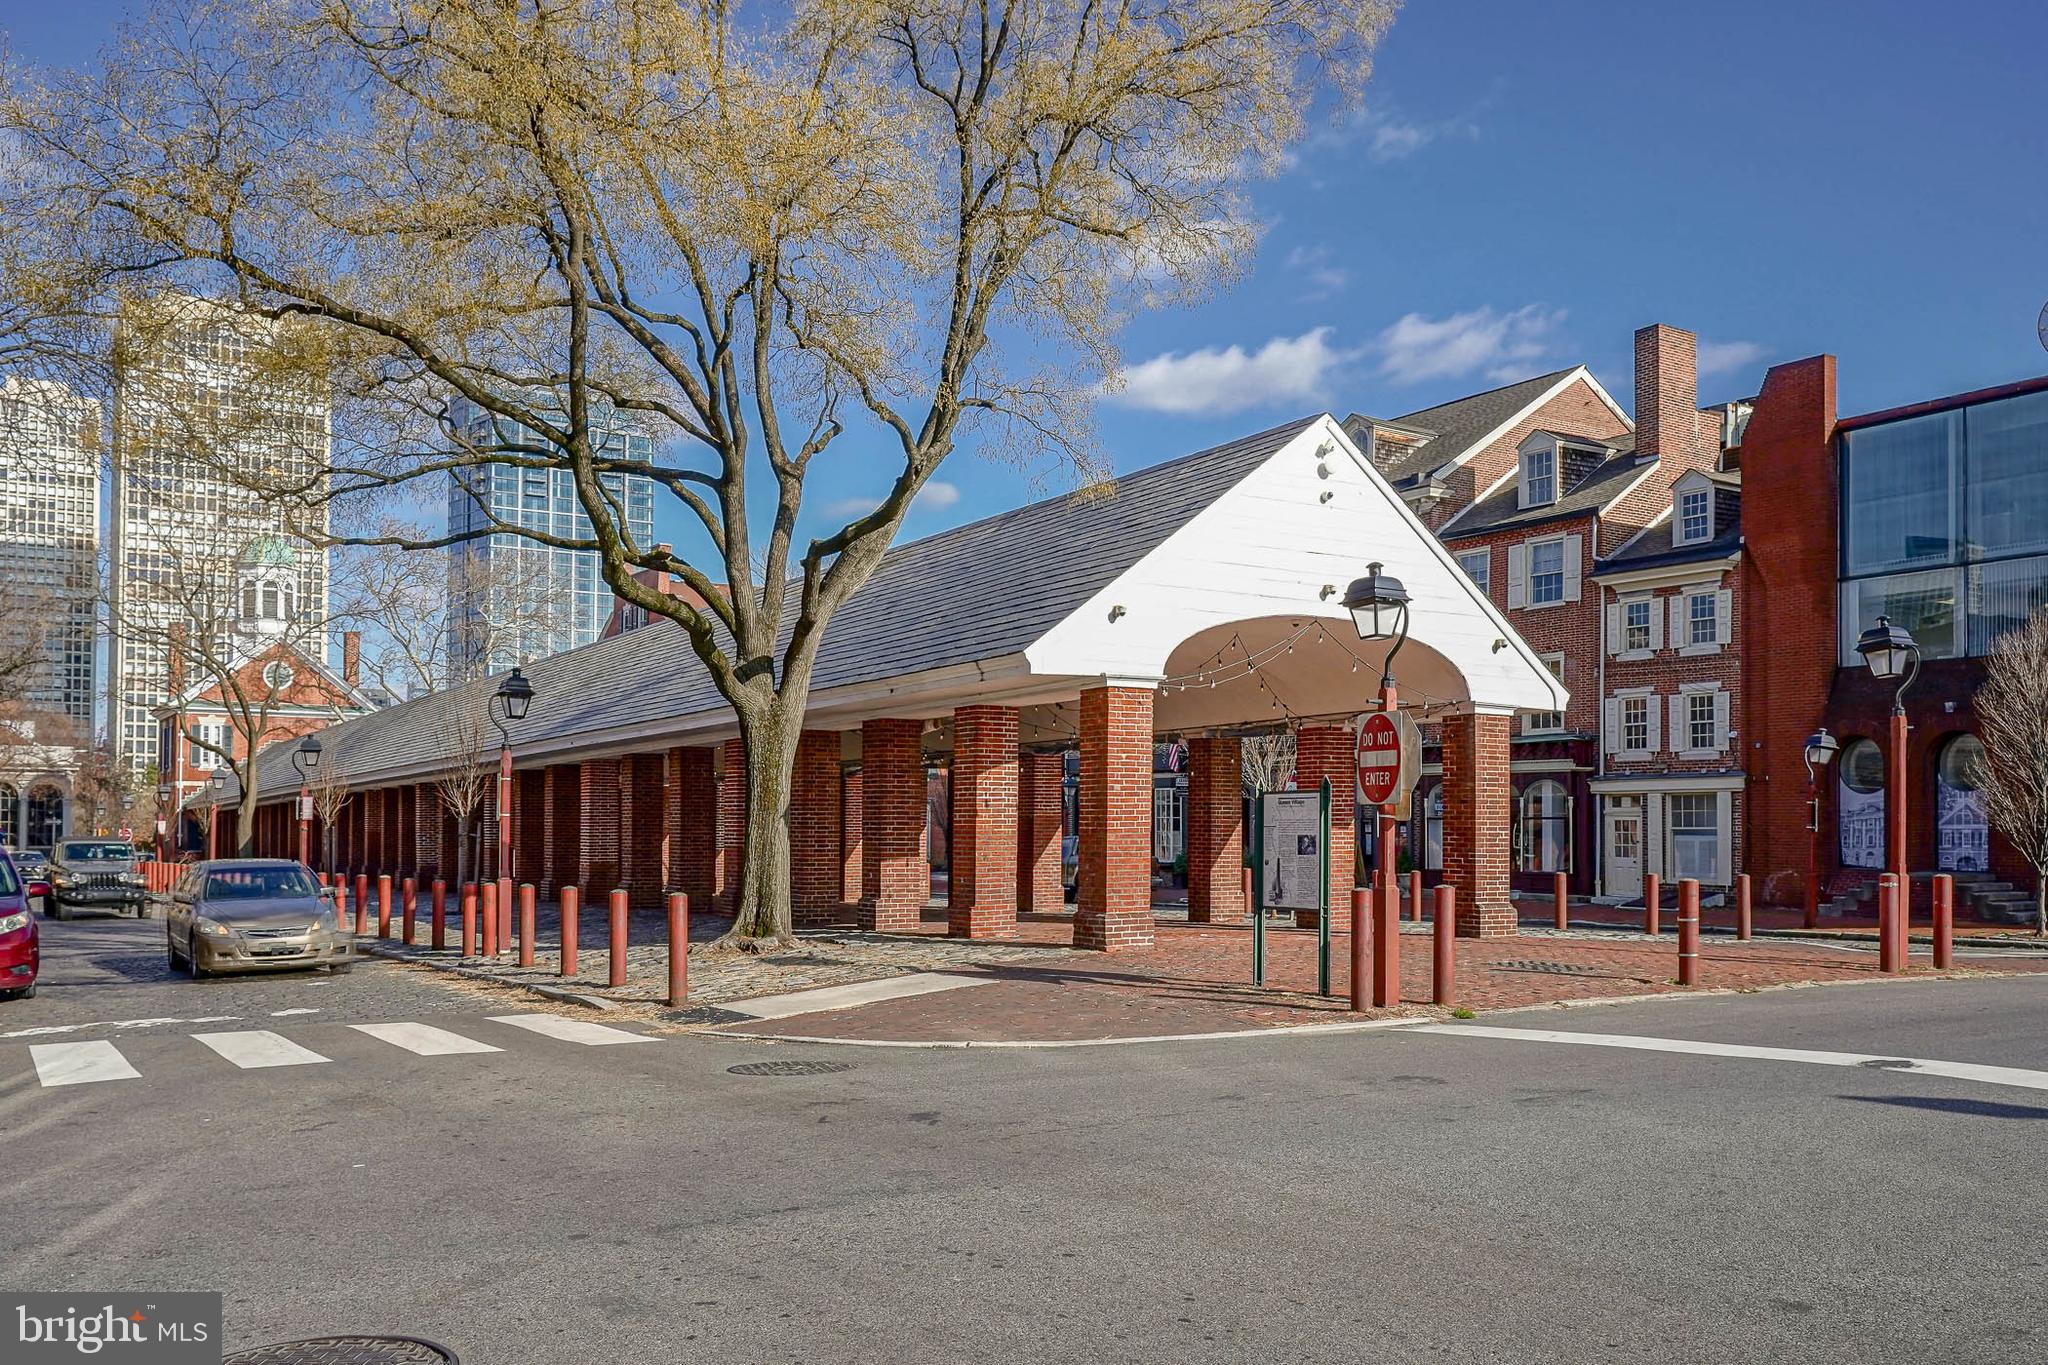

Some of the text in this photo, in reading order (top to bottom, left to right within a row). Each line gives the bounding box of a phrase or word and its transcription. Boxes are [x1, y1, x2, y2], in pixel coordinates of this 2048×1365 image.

[1363, 731, 1394, 746] DO NOT
[1365, 772, 1390, 785] ENTER
